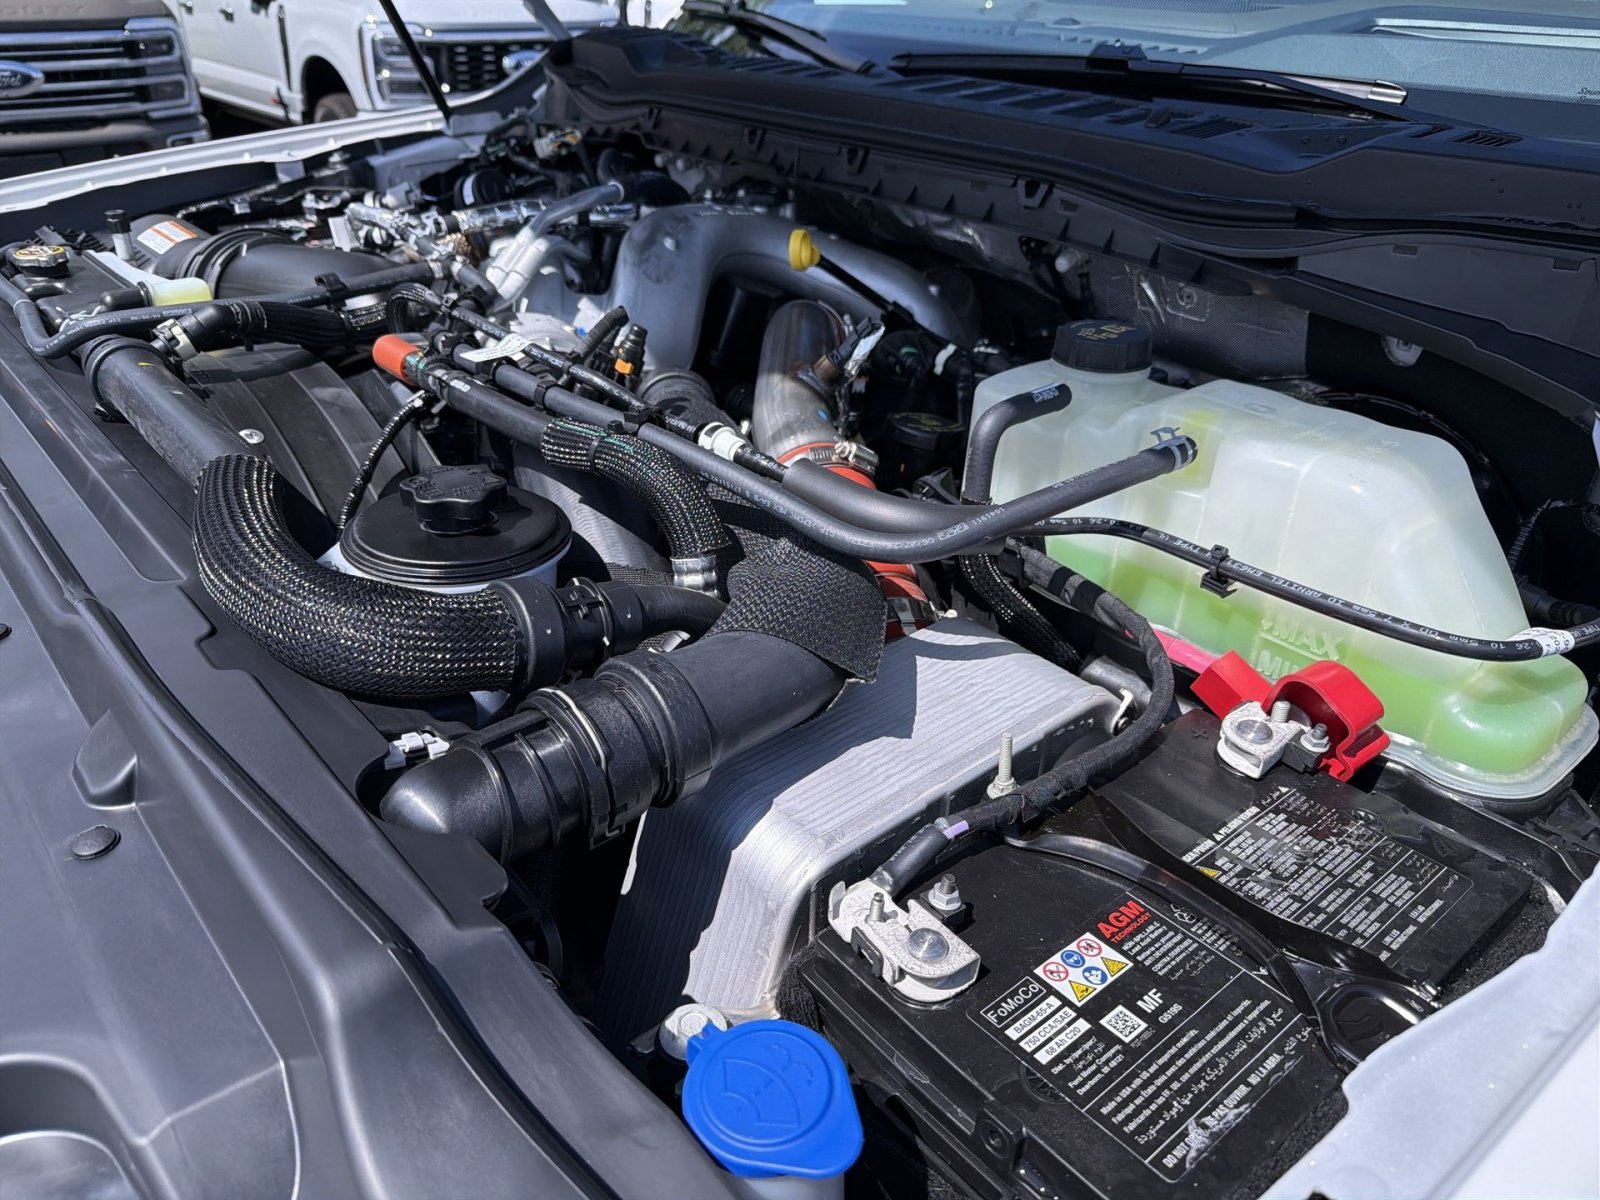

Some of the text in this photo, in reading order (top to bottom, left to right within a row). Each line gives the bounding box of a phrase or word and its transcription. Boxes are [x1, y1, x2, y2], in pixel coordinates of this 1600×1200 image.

[0, 72, 21, 87] ord
[1158, 532, 1169, 540] UL
[1173, 538, 1201, 553] TYPE
[1270, 575, 1322, 598] ARNITEL
[1327, 596, 1343, 607] ID
[1271, 614, 1344, 660] MAX
[1402, 621, 1412, 629] X
[1418, 626, 1439, 637] OD
[1096, 899, 1145, 939] AGM
[1110, 911, 1151, 943] TECHNOLOGY
[1127, 943, 1142, 955] Lead
[1139, 936, 1152, 947] Acid
[986, 983, 1039, 1023] FoMoCo
[1135, 987, 1163, 1013] MF
[1157, 1002, 1182, 1023] G519S
[1012, 1001, 1054, 1034] BAGM-65-A
[1023, 1009, 1072, 1048] 750 CCA/SAE
[1044, 1025, 1081, 1056] 68 Ah C20
[1067, 1074, 1083, 1088] Ford
[1079, 1062, 1097, 1078] Motor
[1075, 1053, 1124, 1095] Dearborn, MI 48121
[1099, 1100, 1117, 1115] Made
[1113, 1095, 1123, 1103] in
[1118, 1085, 1133, 1098] USA
[1129, 1077, 1143, 1089] with
[1138, 1070, 1150, 1080] US
[1147, 1062, 1159, 1074] and
[1154, 1044, 1179, 1066] imported
[1110, 1101, 1136, 1124] Fabriqué
[1133, 1095, 1145, 1105] aux
[1164, 1064, 1178, 1077] avec
[1174, 1056, 1187, 1067] des
[1148, 1102, 1158, 1111] en
[1153, 1095, 1166, 1105] los
[1179, 1071, 1190, 1082] con
[1161, 1153, 1178, 1168] DO
[1171, 1141, 1189, 1159] NOT
[1211, 1103, 1230, 1120] PAS
[1222, 1083, 1251, 1108] OUVRIR.
[1246, 1072, 1261, 1085] NO
[1254, 1066, 1269, 1078] LA
[1262, 1052, 1284, 1071] ABRA.
